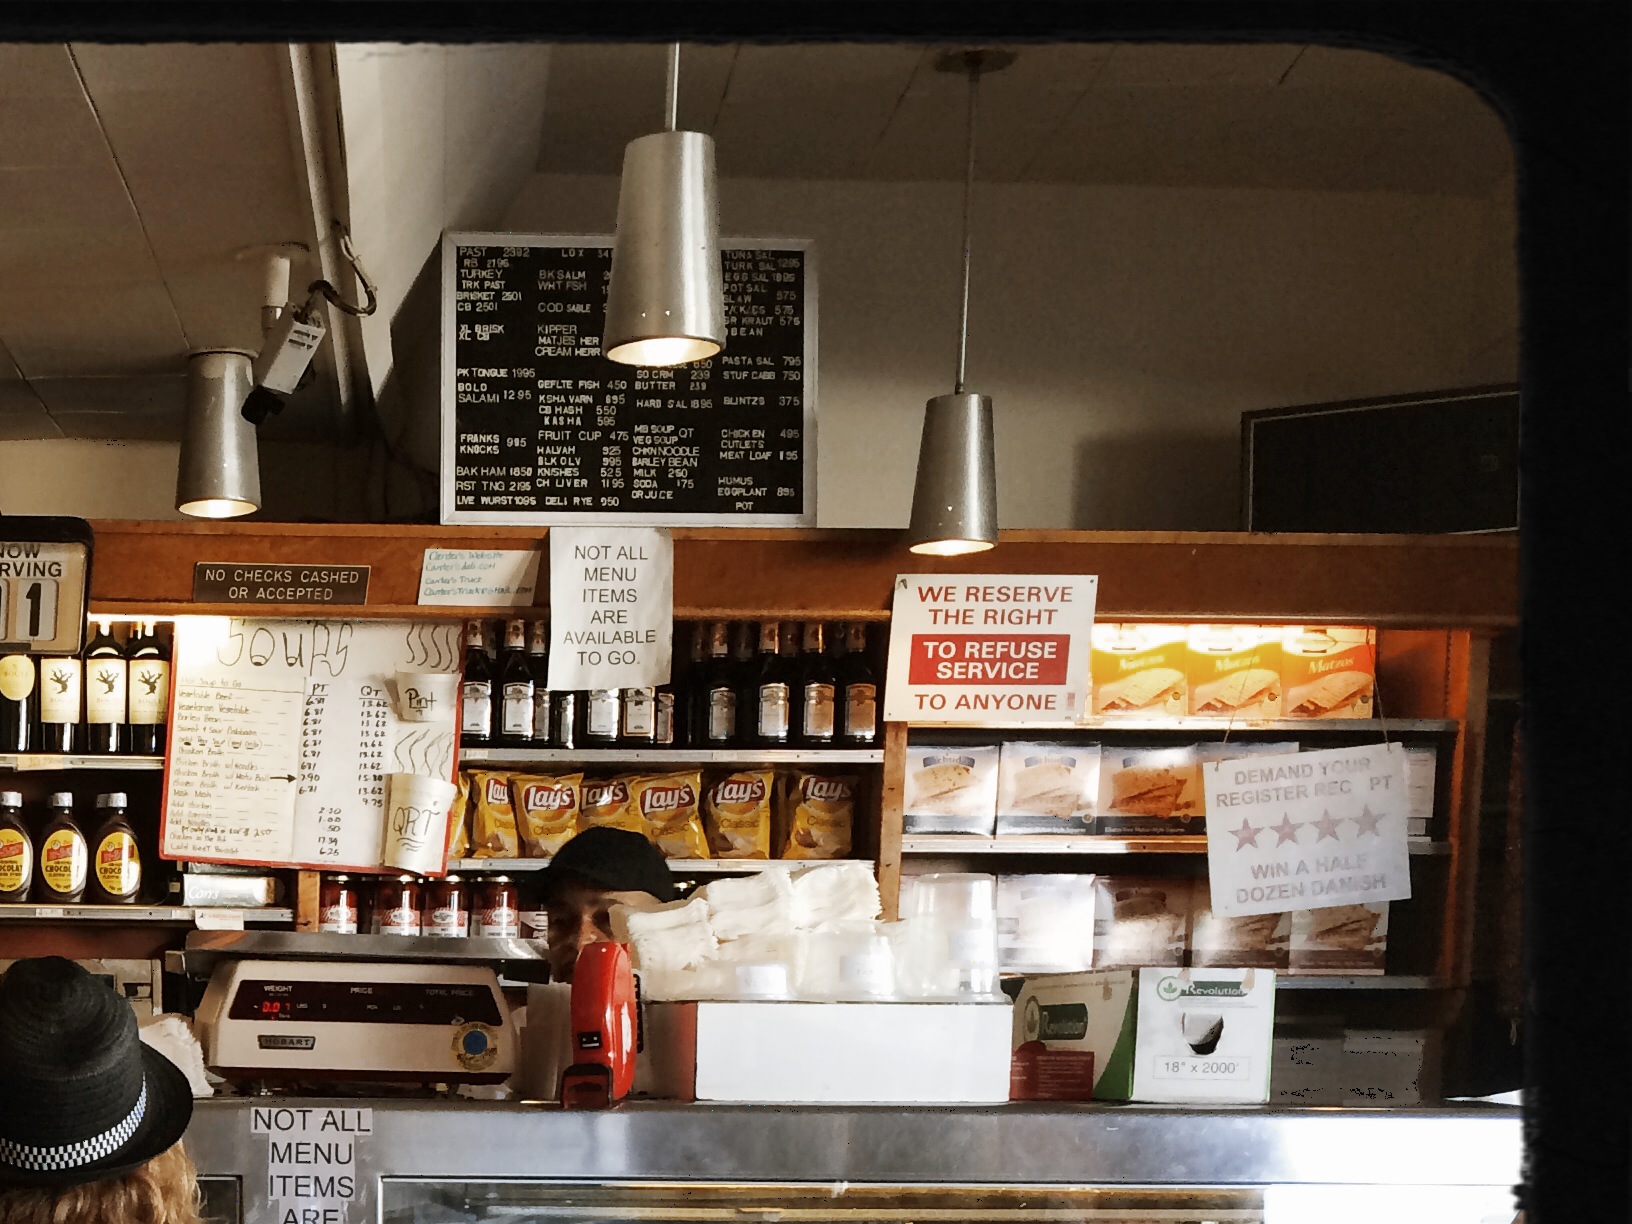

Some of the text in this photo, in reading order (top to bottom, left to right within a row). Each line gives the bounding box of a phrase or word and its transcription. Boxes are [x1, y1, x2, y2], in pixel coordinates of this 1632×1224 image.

[460, 269, 503, 279] TURKEY
[538, 302, 563, 312] COD
[537, 325, 577, 334] KIPPER
[538, 336, 599, 345] MATJES HER
[579, 380, 600, 389] FISH
[634, 381, 675, 390] BUTTER
[459, 393, 500, 403] SALAMI
[596, 406, 617, 415] 550
[538, 431, 571, 441] FRUIT
[578, 431, 602, 440] CUP
[668, 458, 698, 467] BEAN
[480, 467, 506, 476] HAM
[633, 469, 656, 477] MILK
[574, 545, 649, 561] NOT ALL
[205, 569, 359, 584] NO CHECKS CASHED
[584, 567, 637, 582] MENU
[228, 587, 333, 600] OR ACCEPTED
[582, 588, 638, 604] ITEMS
[918, 586, 1074, 603] WE RESERVE
[590, 610, 628, 625] ARE
[928, 609, 1059, 626] THE RIGHT
[563, 630, 656, 645] AVAILABLE
[923, 641, 1057, 659] TO REFUSE
[577, 650, 604, 666] TO
[1309, 657, 1354, 674] Matzos
[936, 662, 1039, 680] SERVICE
[914, 693, 1057, 711] TO ANYONE
[1235, 757, 1371, 785] DEMAND YOUR
[715, 779, 762, 804] Lay's
[806, 776, 852, 800] Lay's
[528, 784, 574, 811] Lay's
[644, 786, 690, 813] Lay's
[1216, 785, 1308, 808] REGISTER
[721, 816, 759, 829] Classic
[806, 815, 846, 829] Classic
[1251, 853, 1367, 880] WIN A HALF
[1236, 873, 1386, 904] DOZEN DANISH
[264, 985, 293, 993] WEIGHT
[264, 1038, 311, 1046] HOBART
[1190, 1065, 1197, 1073] x
[254, 1109, 370, 1132] NOT ALL
[271, 1142, 352, 1165] MENU
[269, 1176, 354, 1198] ITEMS
